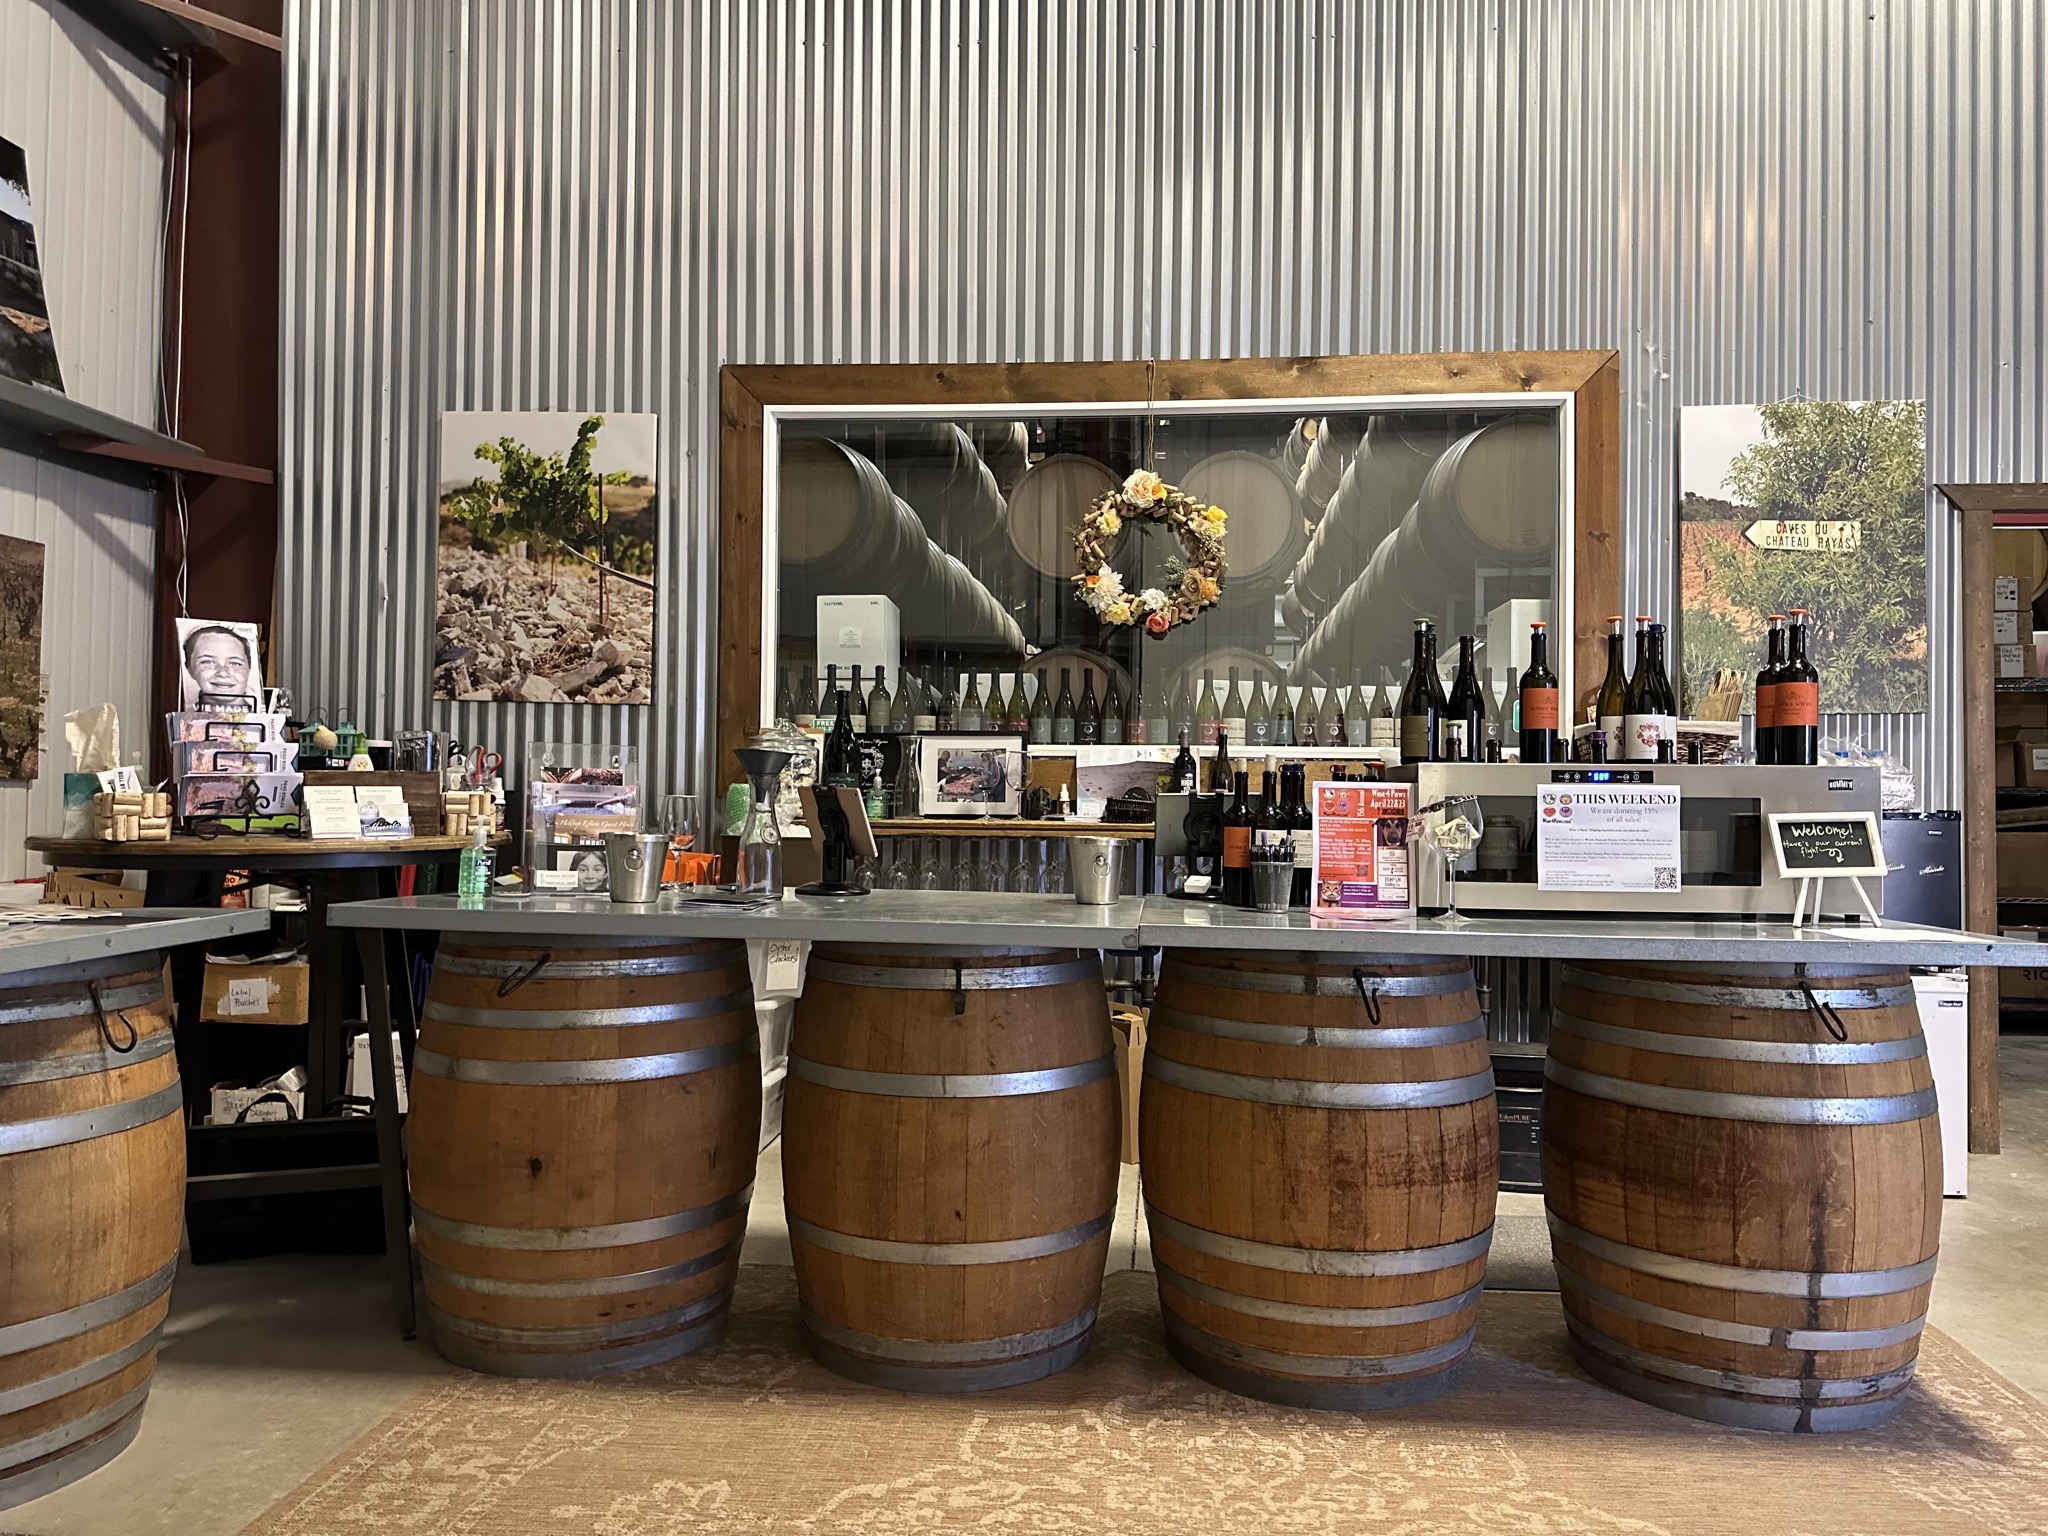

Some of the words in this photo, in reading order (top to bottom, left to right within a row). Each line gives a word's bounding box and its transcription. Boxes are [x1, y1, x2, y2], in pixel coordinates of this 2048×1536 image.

[1776, 523, 1807, 534] CAVES
[1815, 523, 1828, 534] DU
[1766, 535, 1810, 548] CHATEAU
[1818, 537, 1851, 549] RAYAS
[216, 704, 249, 713] MADE
[1371, 788, 1386, 797] Wine
[1385, 788, 1391, 797] 4
[1391, 789, 1406, 797] Paws
[1573, 793, 1606, 804] THIS
[1608, 794, 1677, 804] WEEKEND
[1370, 799, 1386, 810] April
[1614, 807, 1643, 816] donating
[1791, 822, 1853, 839] Welcome!
[1783, 839, 1809, 849] Here's
[1834, 838, 1863, 847] current
[1800, 846, 1819, 858] flight
[231, 987, 251, 997] Label
